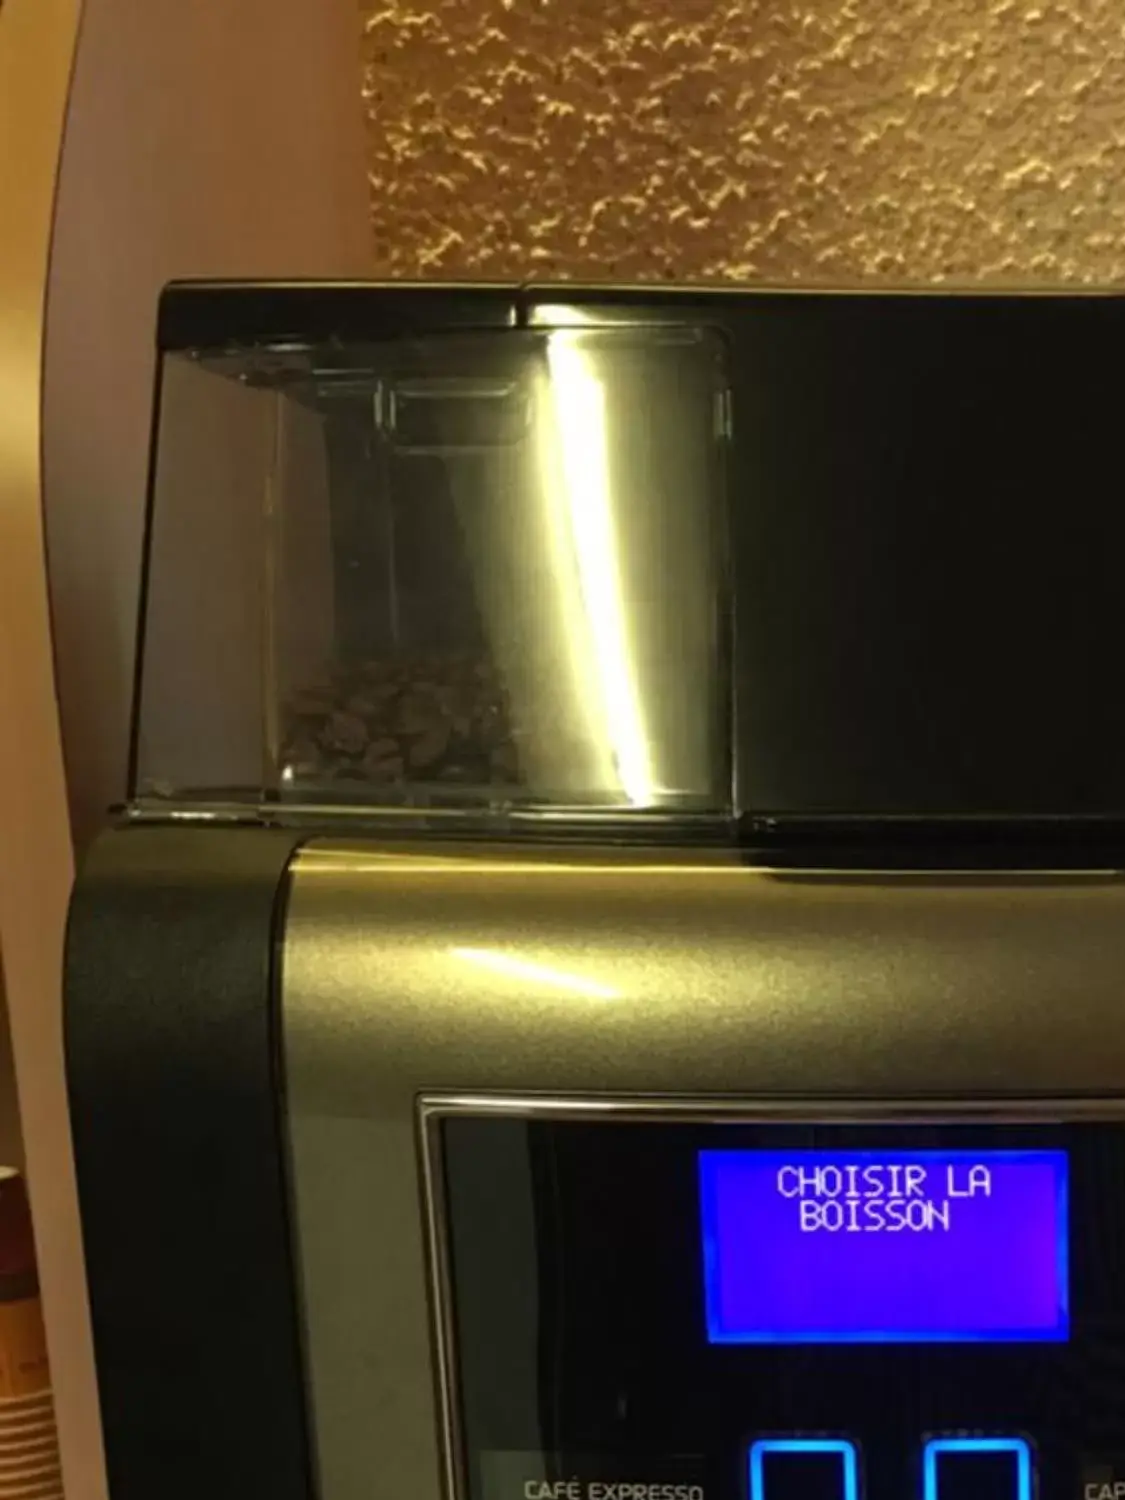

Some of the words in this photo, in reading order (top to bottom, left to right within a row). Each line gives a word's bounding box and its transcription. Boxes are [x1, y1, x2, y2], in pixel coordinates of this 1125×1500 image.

[776, 1164, 927, 1198] CHOISIR
[947, 1164, 992, 1198] LA
[800, 1199, 950, 1232] BOISSON
